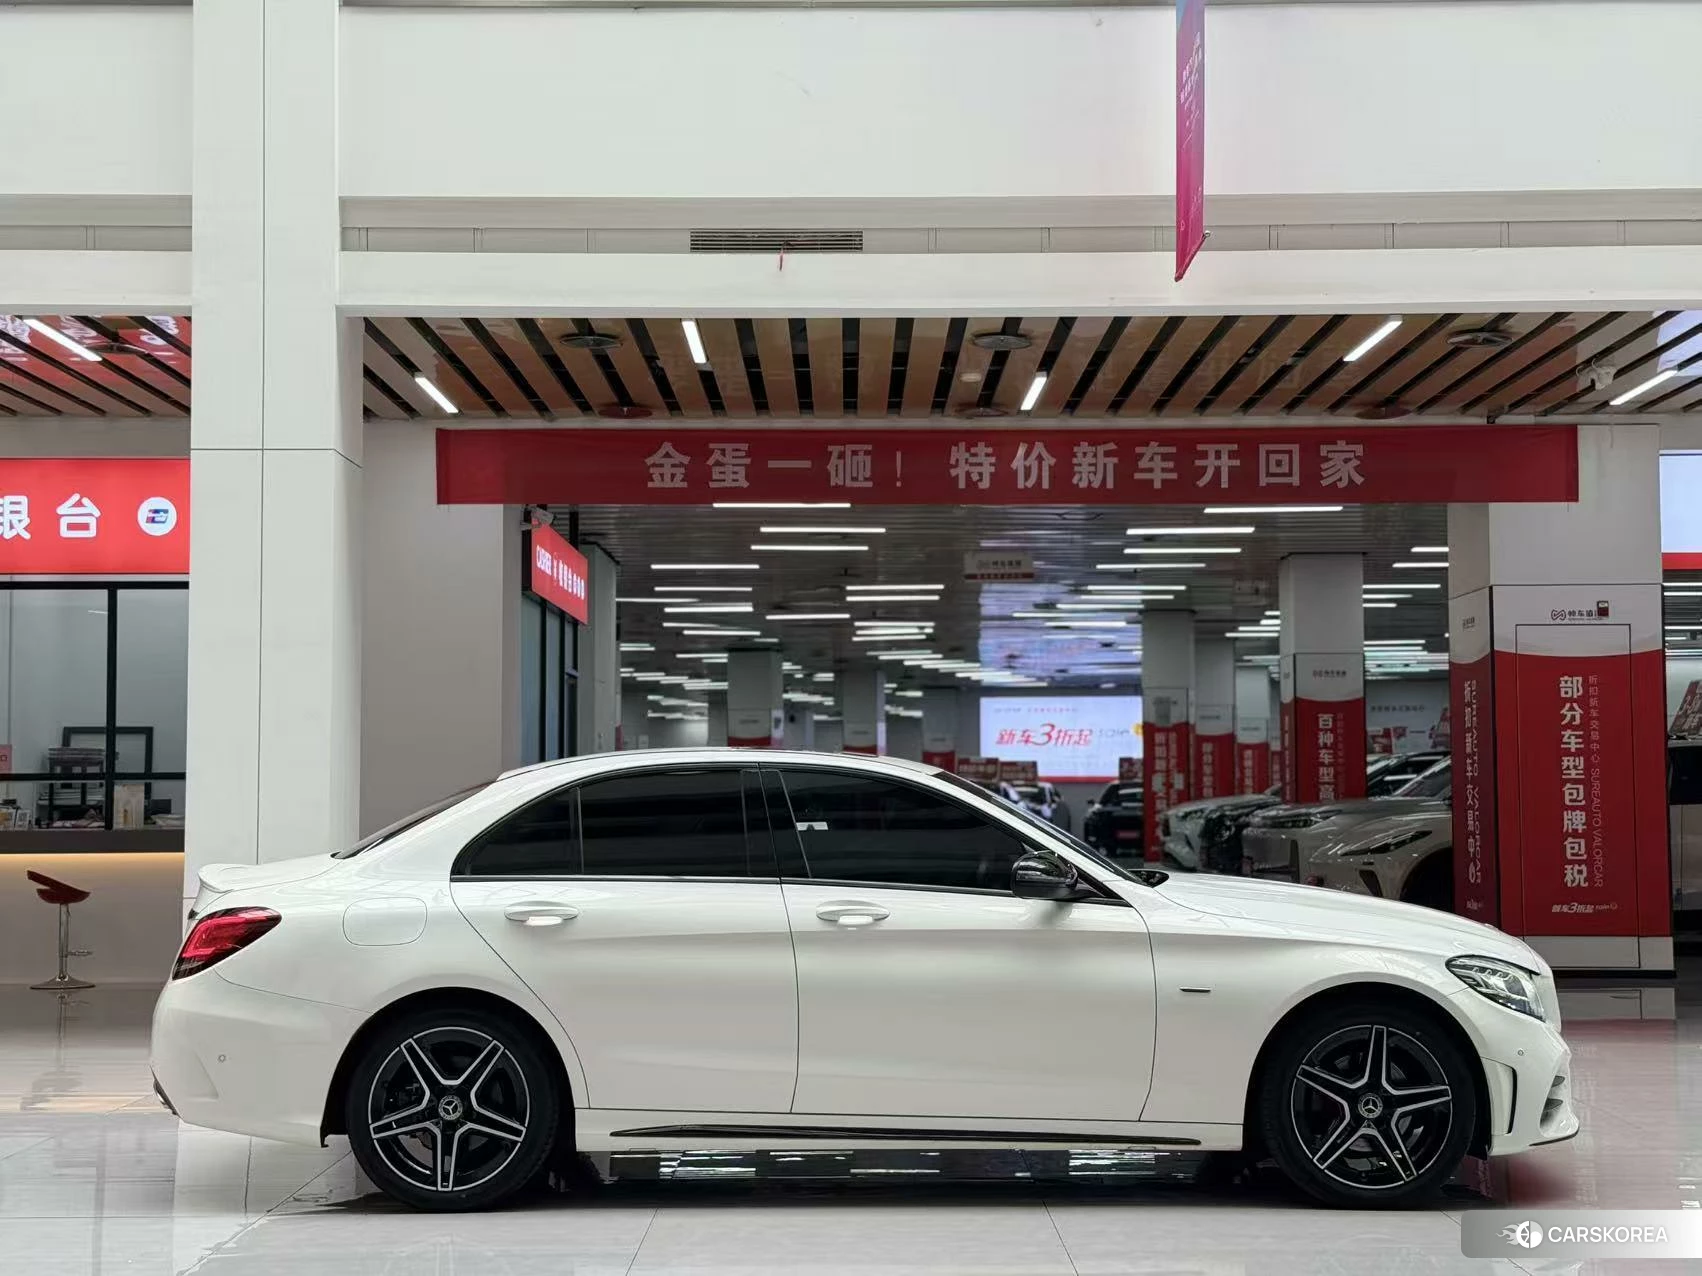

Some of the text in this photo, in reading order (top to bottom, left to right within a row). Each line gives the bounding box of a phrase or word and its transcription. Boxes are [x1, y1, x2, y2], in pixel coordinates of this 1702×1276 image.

[949, 440, 1366, 489] 特价新车开回家
[1559, 675, 1589, 888] 部分车型包牌包税
